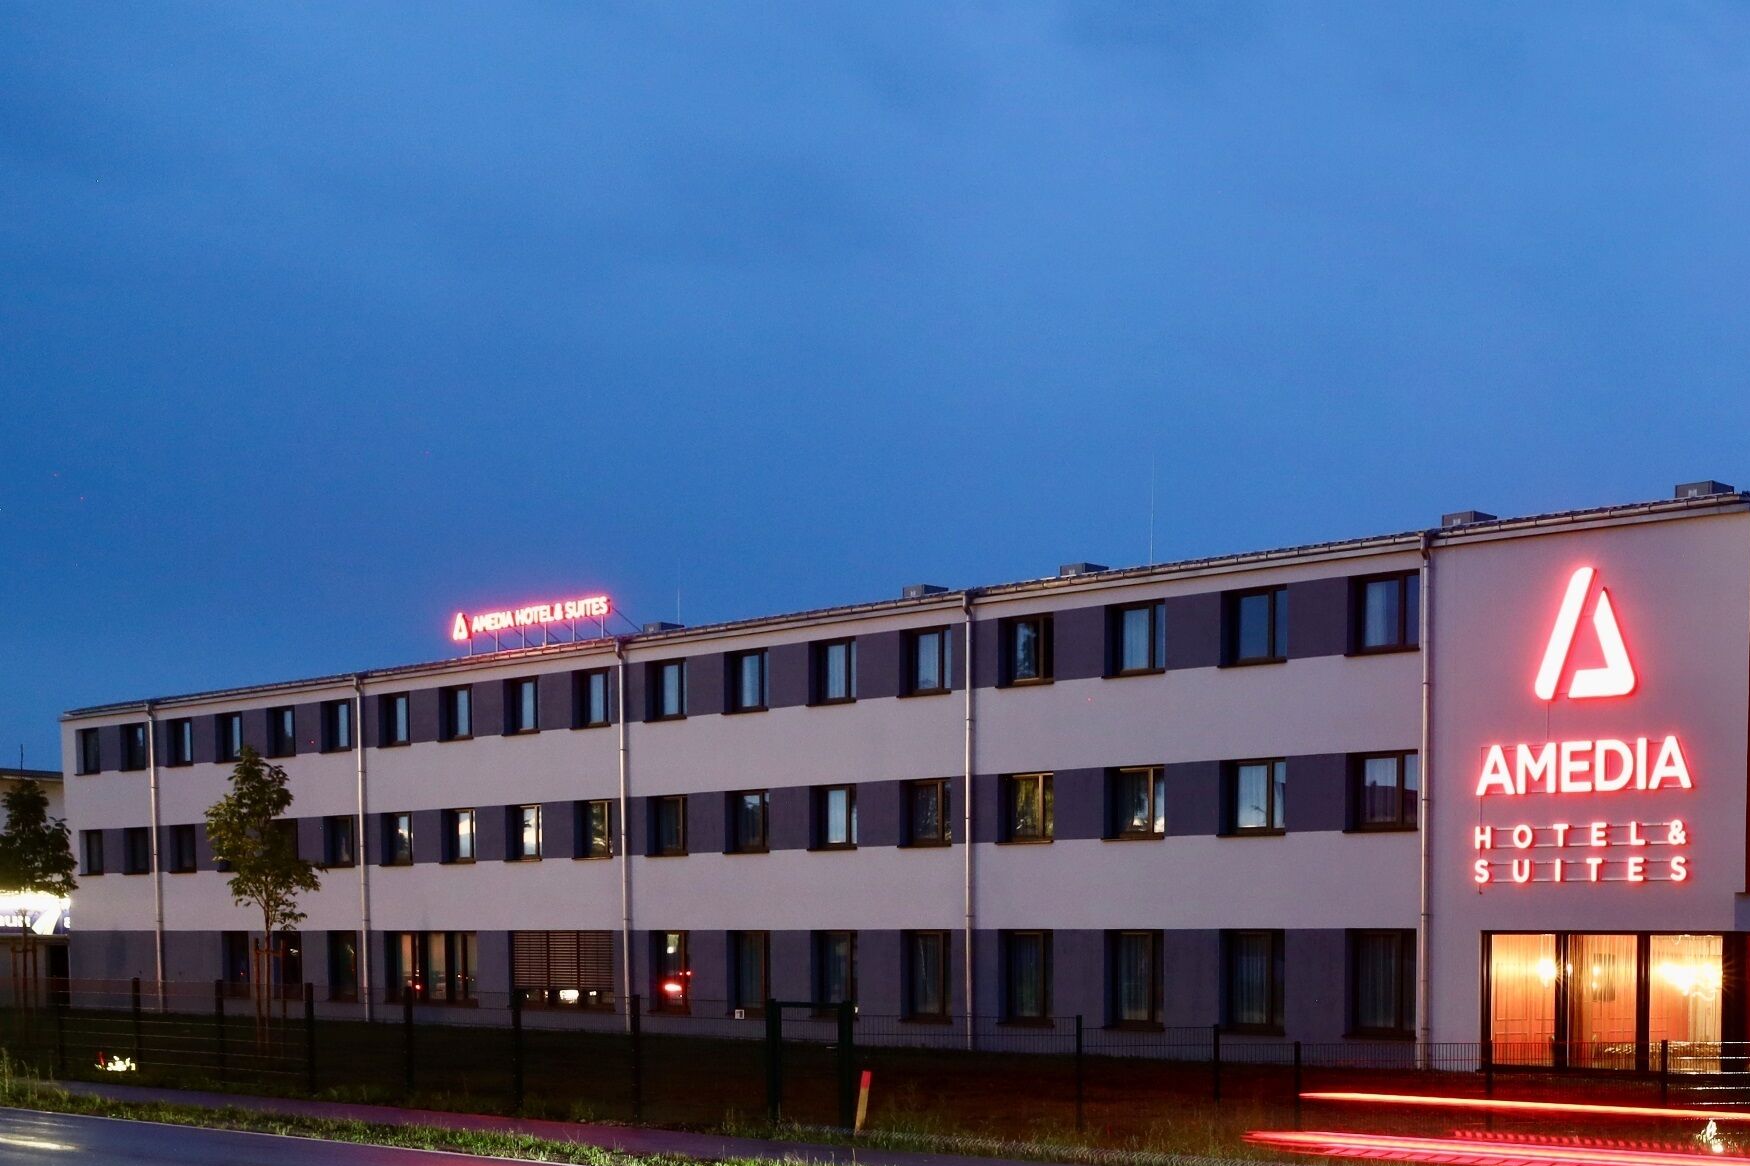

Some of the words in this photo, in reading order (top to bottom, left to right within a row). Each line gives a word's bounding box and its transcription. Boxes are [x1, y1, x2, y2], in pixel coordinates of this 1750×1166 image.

[565, 596, 608, 619] SUITES
[1475, 735, 1693, 796] AMEDIA
[1474, 856, 1687, 883] SUITES
